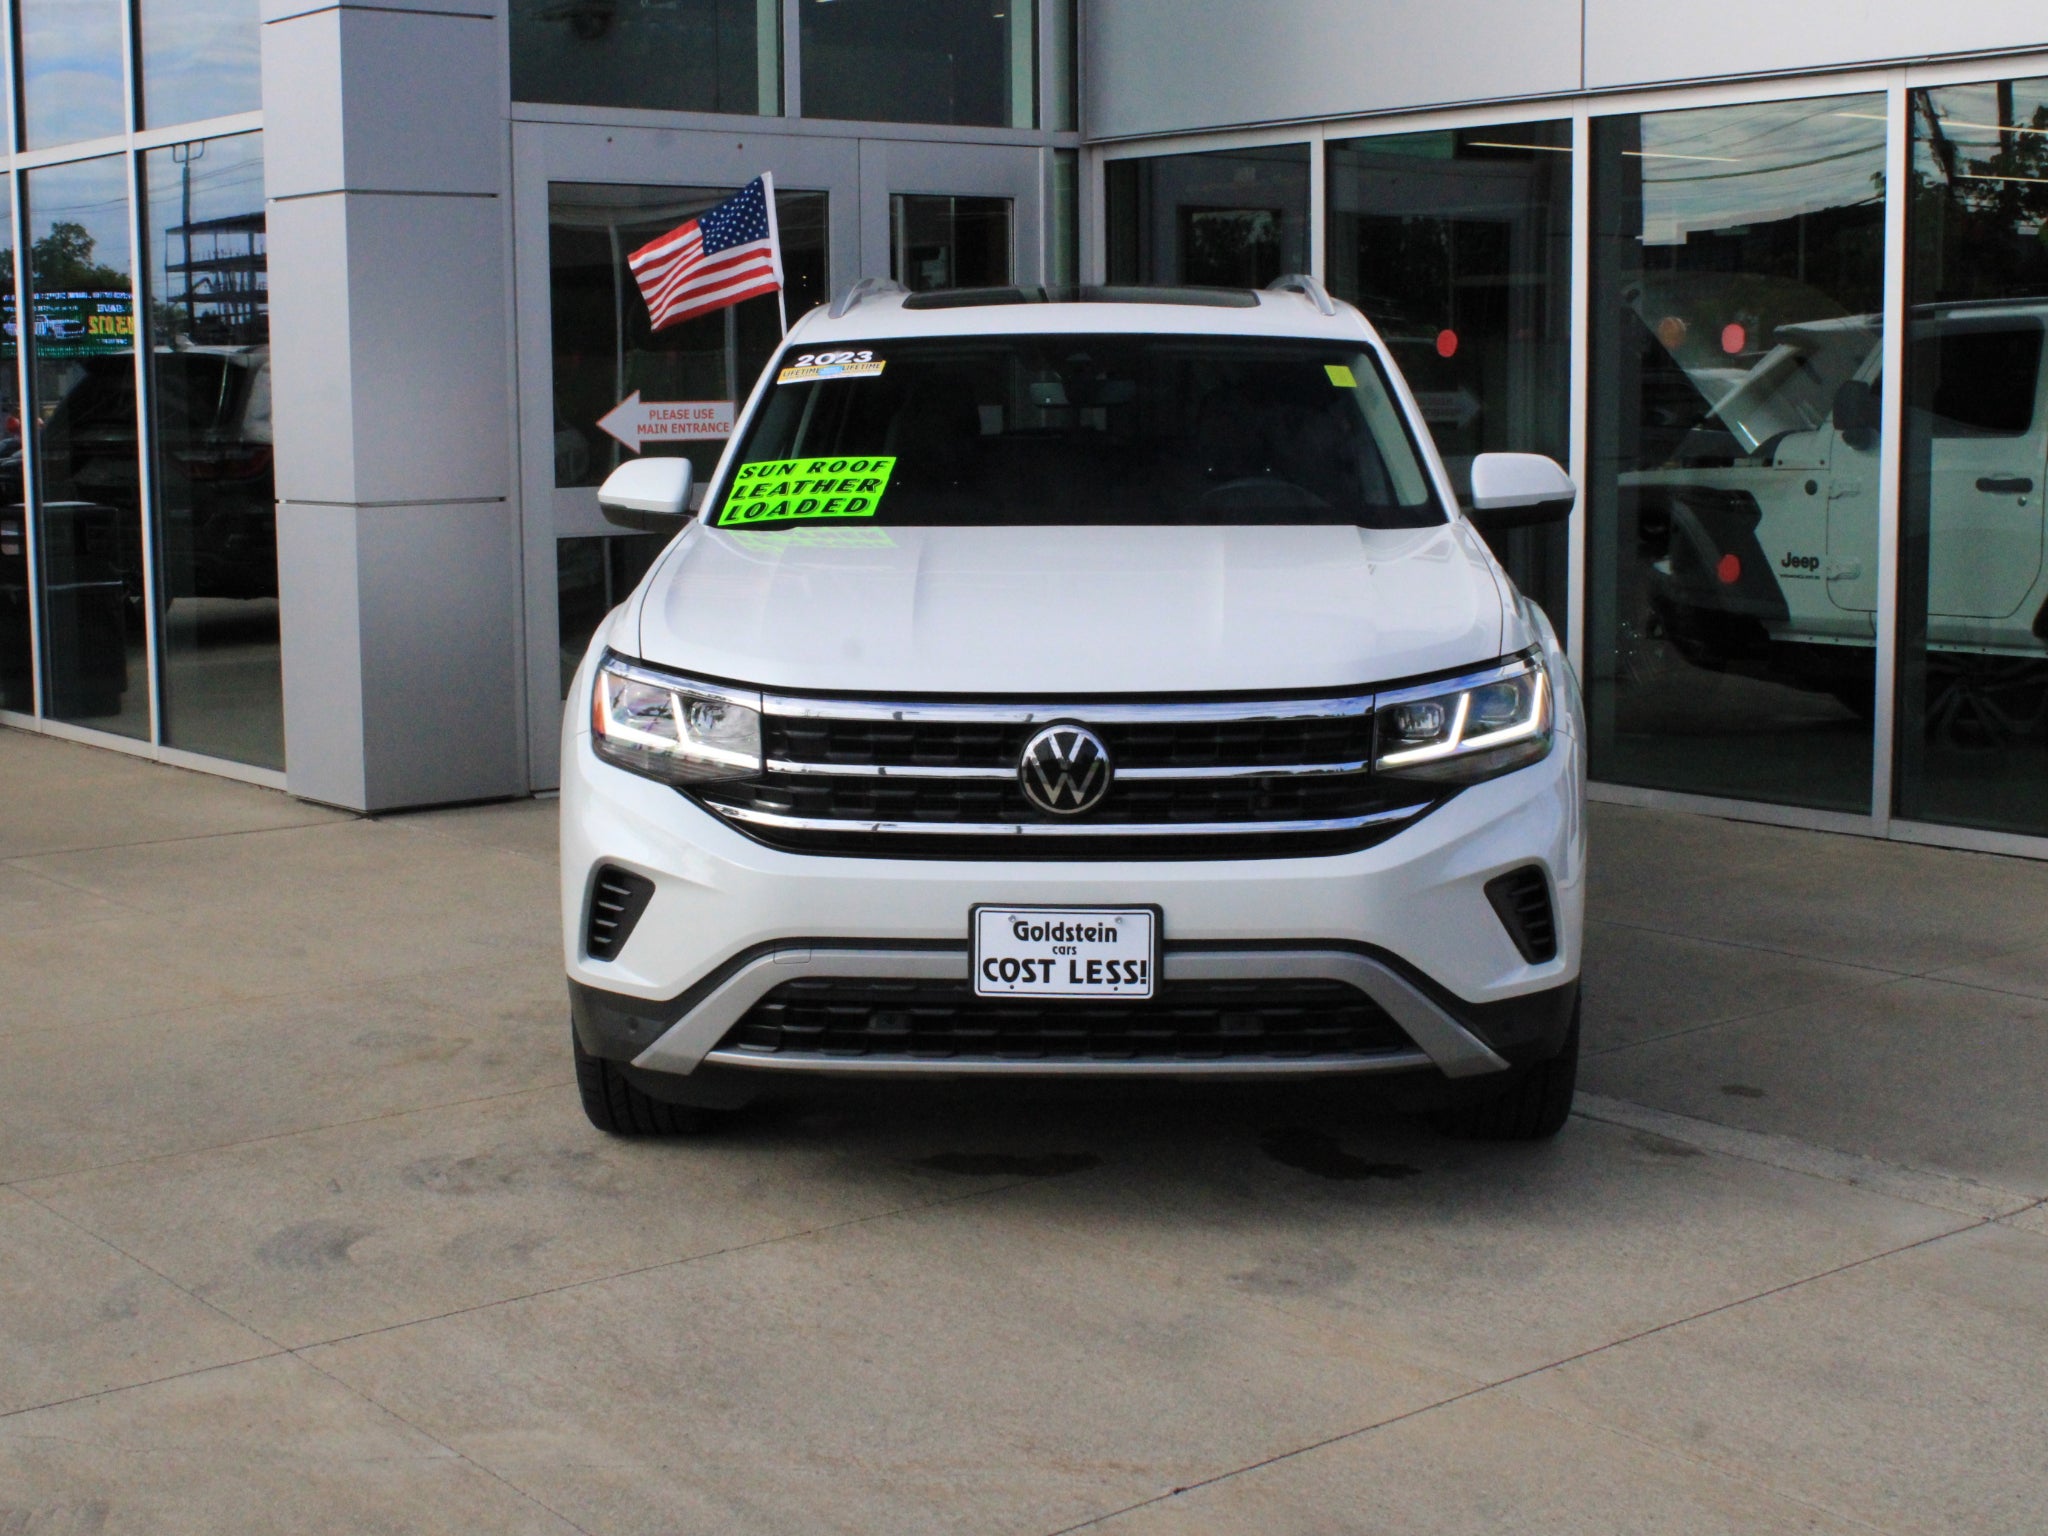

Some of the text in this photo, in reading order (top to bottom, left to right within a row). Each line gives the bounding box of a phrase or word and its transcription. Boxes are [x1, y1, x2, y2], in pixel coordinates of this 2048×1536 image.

[794, 351, 873, 367] 2023
[783, 363, 880, 377] LIFETIME LIFETIME
[648, 408, 715, 421] PLEASE USE
[637, 422, 730, 435] MAIN ENTRANCE
[739, 460, 889, 480] SUN ROOF
[731, 478, 882, 500] LEATHER
[724, 497, 871, 521] LOADED
[1781, 552, 1820, 572] Jeep
[1012, 920, 1118, 943] Goldstein
[1052, 945, 1077, 956] cars
[982, 957, 1148, 985] COST LESS!
